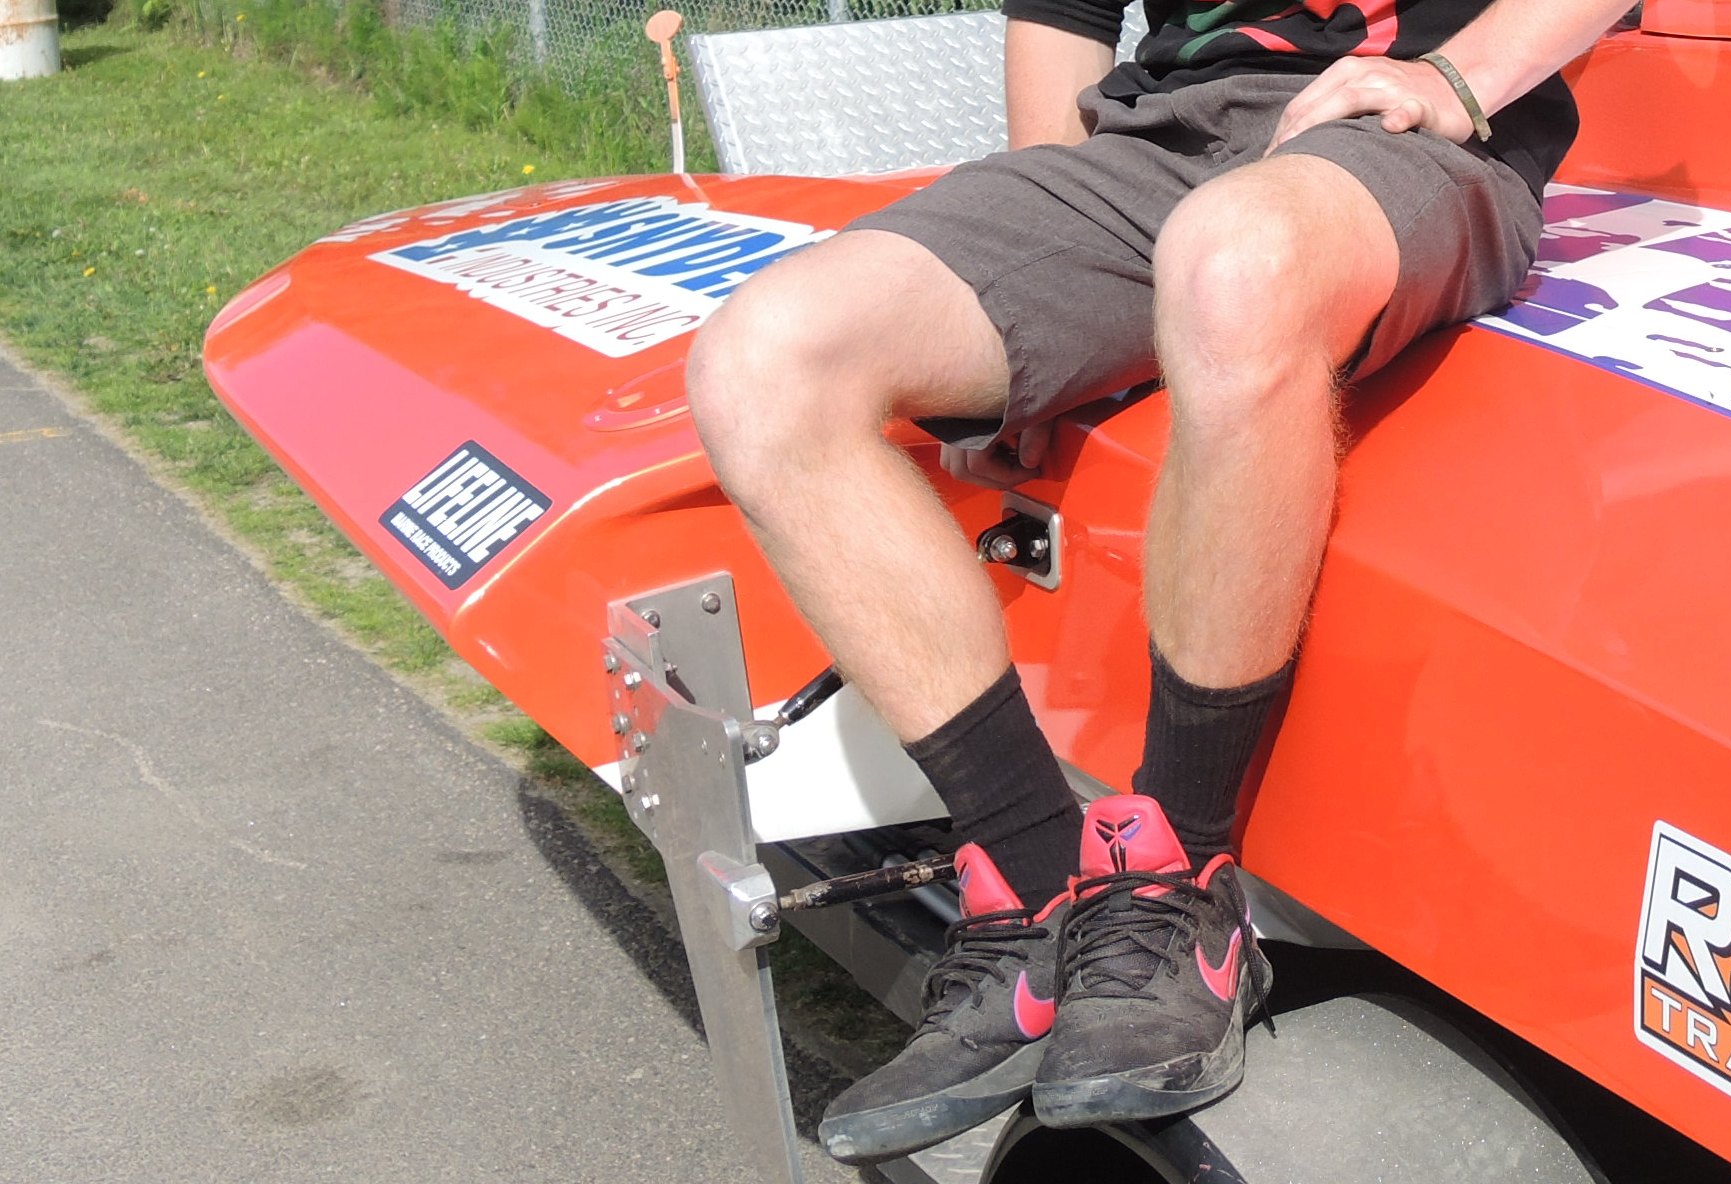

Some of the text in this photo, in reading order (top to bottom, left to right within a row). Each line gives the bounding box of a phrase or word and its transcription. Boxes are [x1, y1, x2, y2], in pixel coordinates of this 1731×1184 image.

[440, 250, 701, 346] INDUSTRIES INC.
[541, 212, 816, 299] SNYDE
[401, 448, 545, 564] LIFELINE
[423, 541, 462, 576] PRODUCTS
